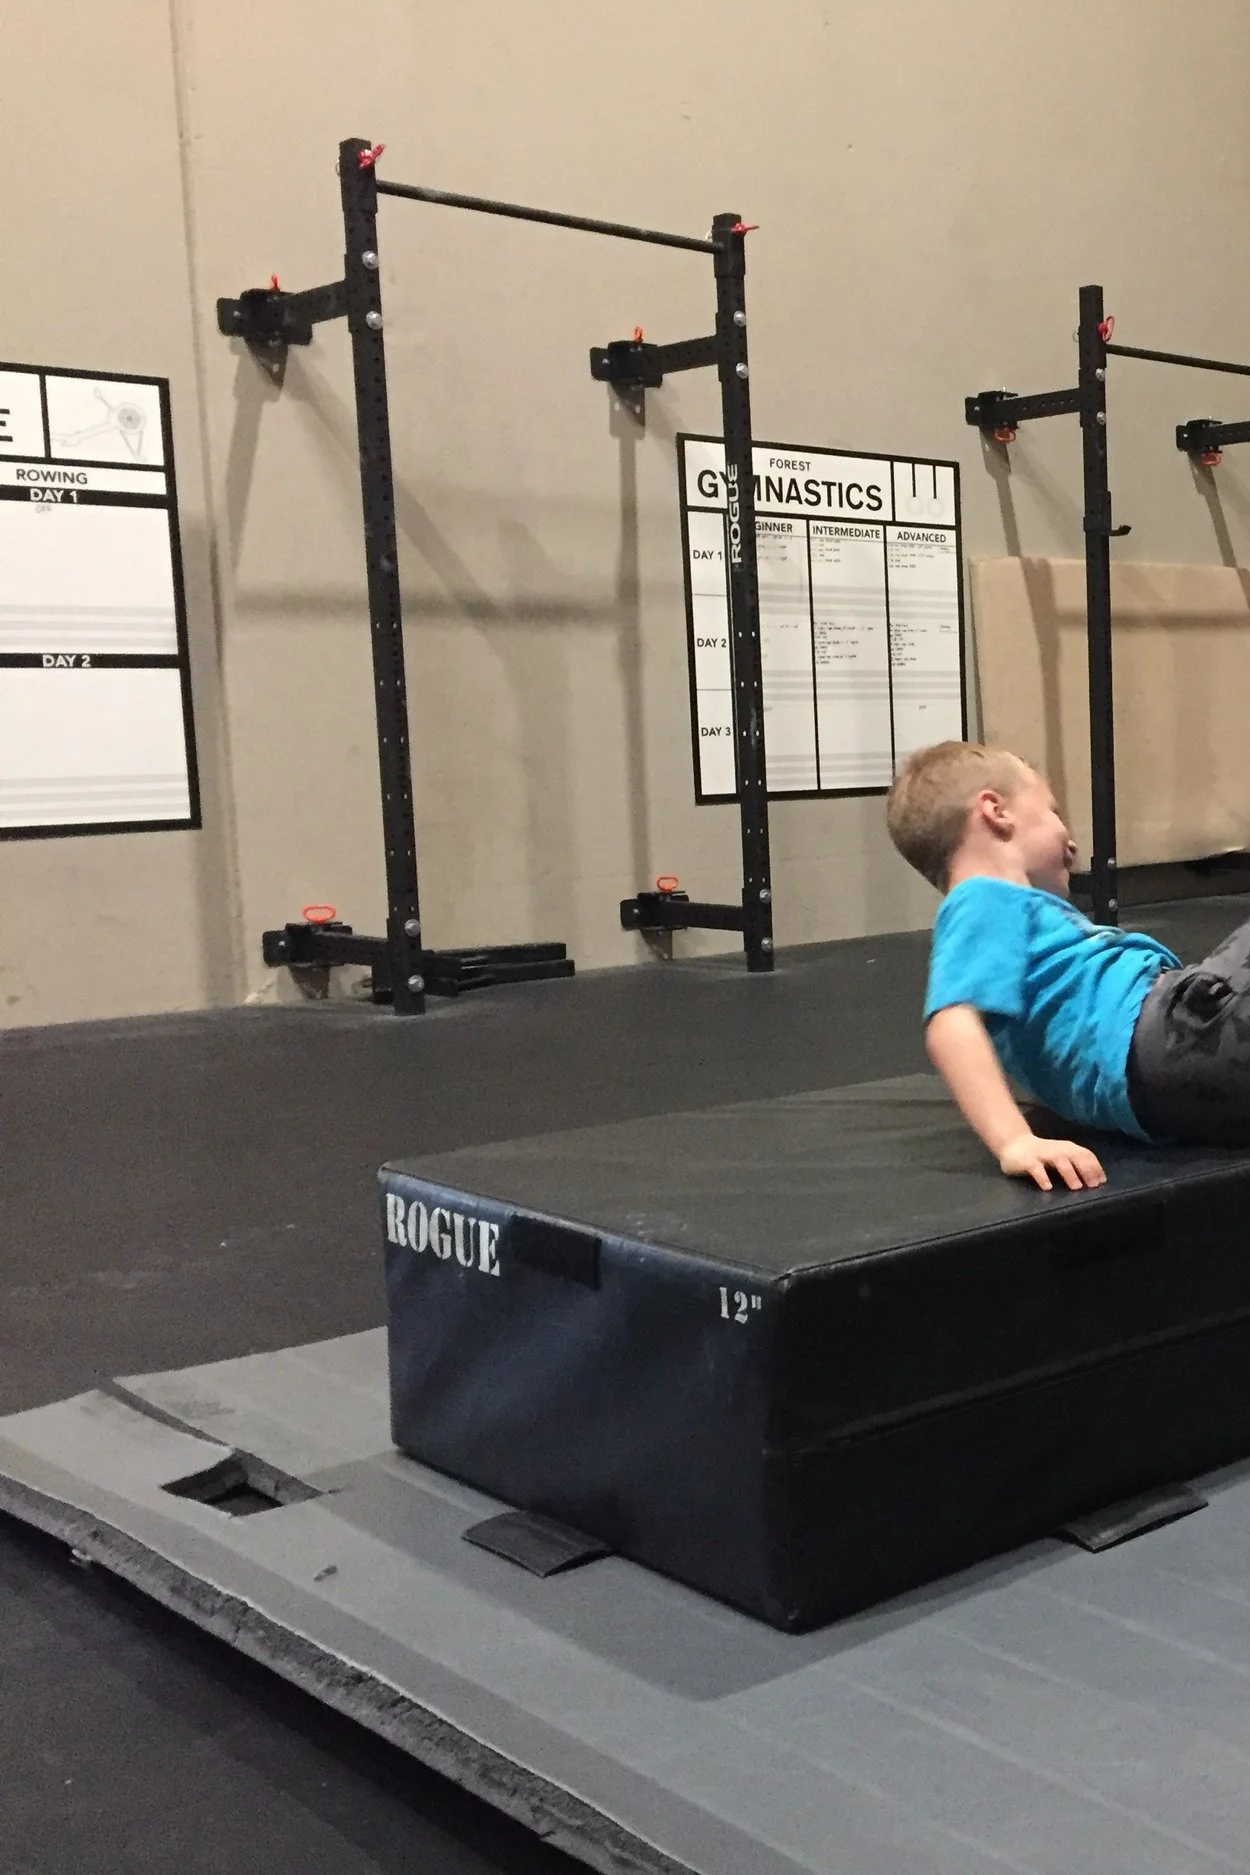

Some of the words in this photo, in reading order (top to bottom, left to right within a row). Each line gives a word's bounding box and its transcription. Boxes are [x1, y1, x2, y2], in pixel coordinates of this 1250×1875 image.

[769, 458, 811, 471] FOREST
[16, 468, 88, 485] ROWING
[30, 488, 64, 502] DAY
[69, 490, 78, 503] 1
[697, 469, 883, 512] GNASTICS
[727, 463, 742, 563] ROGUE
[755, 521, 793, 533] GINNER
[812, 525, 881, 539] INTERMEDIATE
[896, 531, 947, 543] ADVANCED
[693, 549, 714, 560] DAY
[717, 551, 723, 560] 1
[697, 637, 718, 648] DAY
[721, 637, 727, 648] 2
[42, 654, 76, 667] DAY
[81, 655, 91, 668] 2
[701, 726, 722, 737] DAY
[725, 726, 731, 736] 3
[386, 1193, 501, 1277] ROGUE
